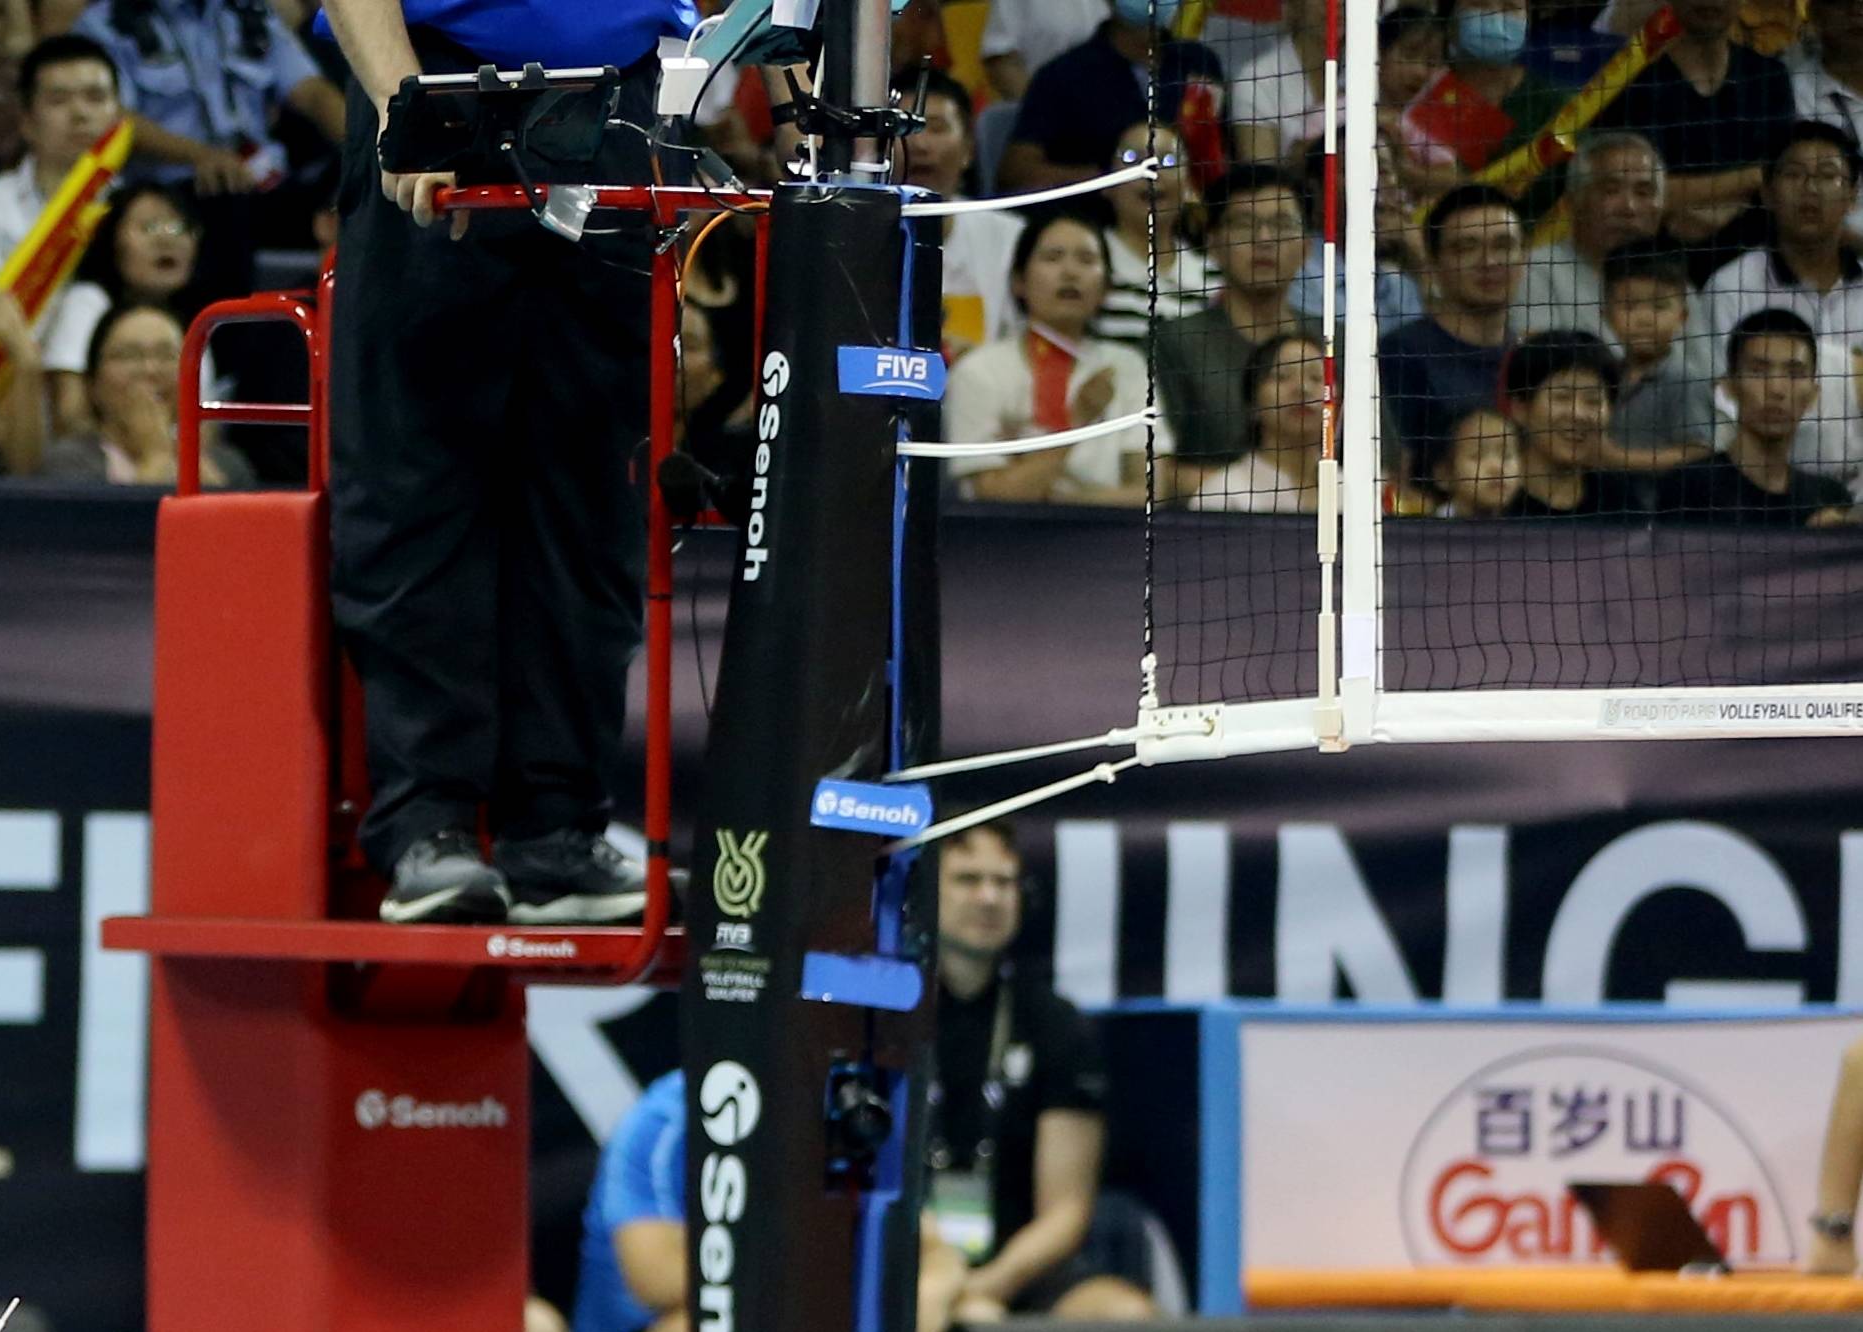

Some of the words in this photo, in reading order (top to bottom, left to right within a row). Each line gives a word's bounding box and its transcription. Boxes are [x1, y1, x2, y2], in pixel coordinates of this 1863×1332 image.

[876, 353, 928, 380] FIVB
[743, 402, 781, 582] Senoh
[1719, 702, 1802, 720] VOLLEYBALL
[837, 796, 919, 826] Senoh
[506, 937, 577, 959] Senoh
[389, 1095, 508, 1129] Senoh
[1473, 1087, 1685, 1160] 百岁山
